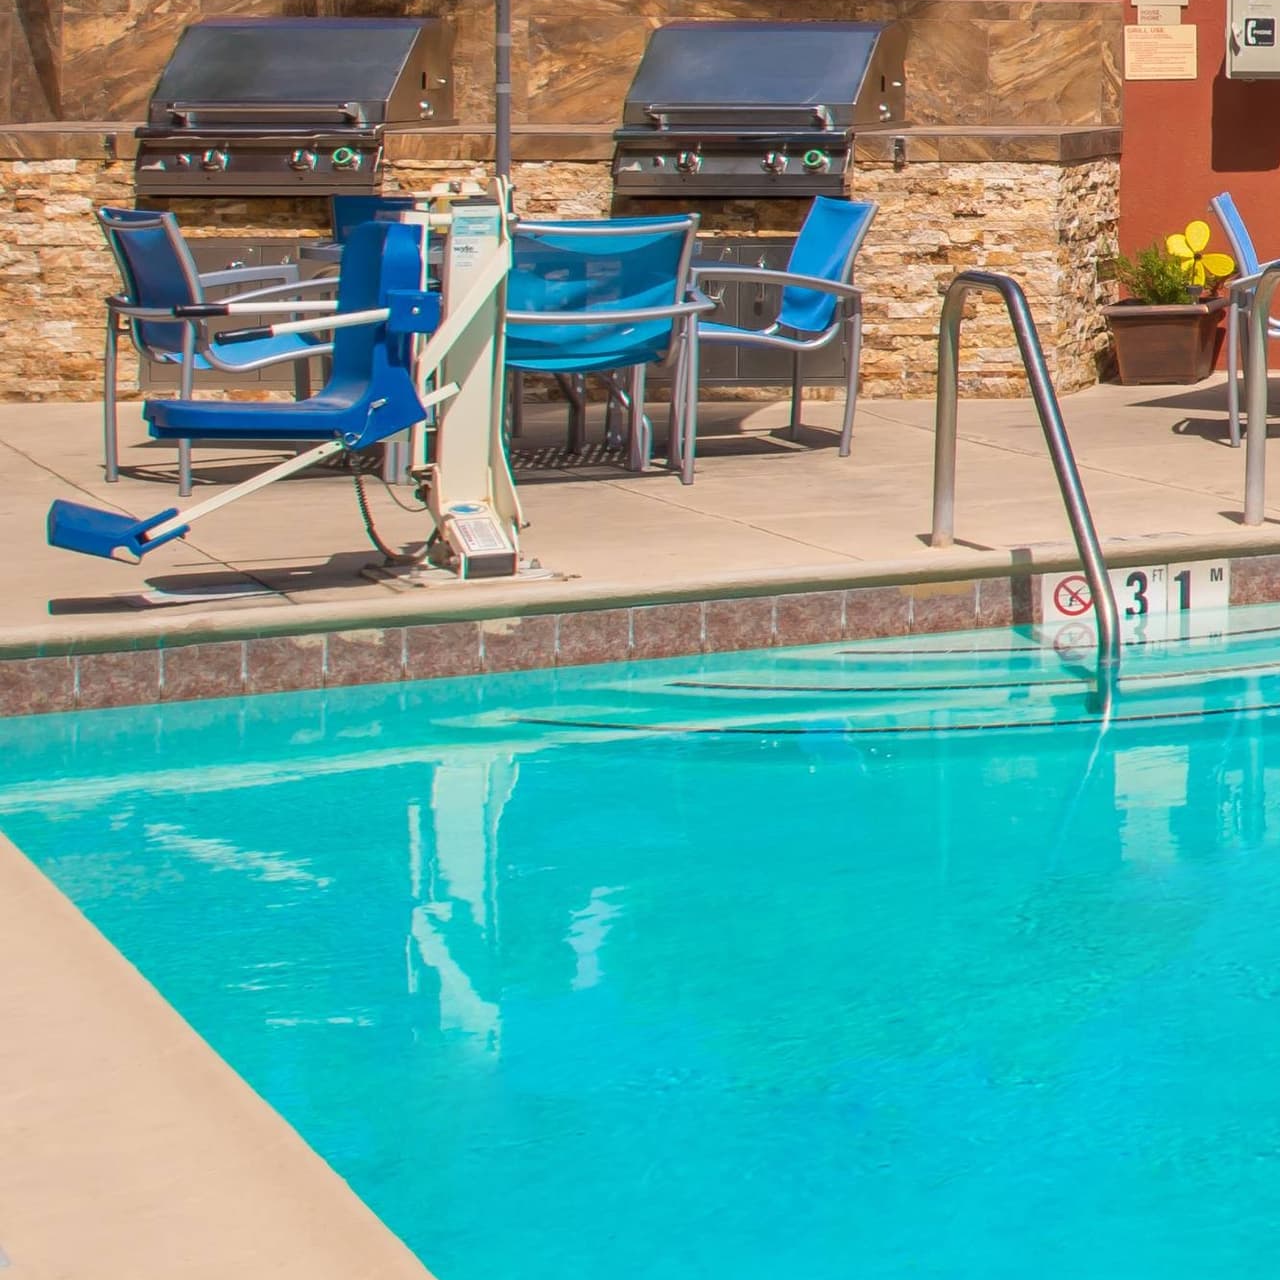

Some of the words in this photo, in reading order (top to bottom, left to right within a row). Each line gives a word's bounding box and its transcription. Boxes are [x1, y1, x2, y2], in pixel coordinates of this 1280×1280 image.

[1125, 571, 1148, 615] 3
[1152, 569, 1163, 582] FT
[1174, 570, 1191, 610] 1
[1210, 568, 1223, 581] M
